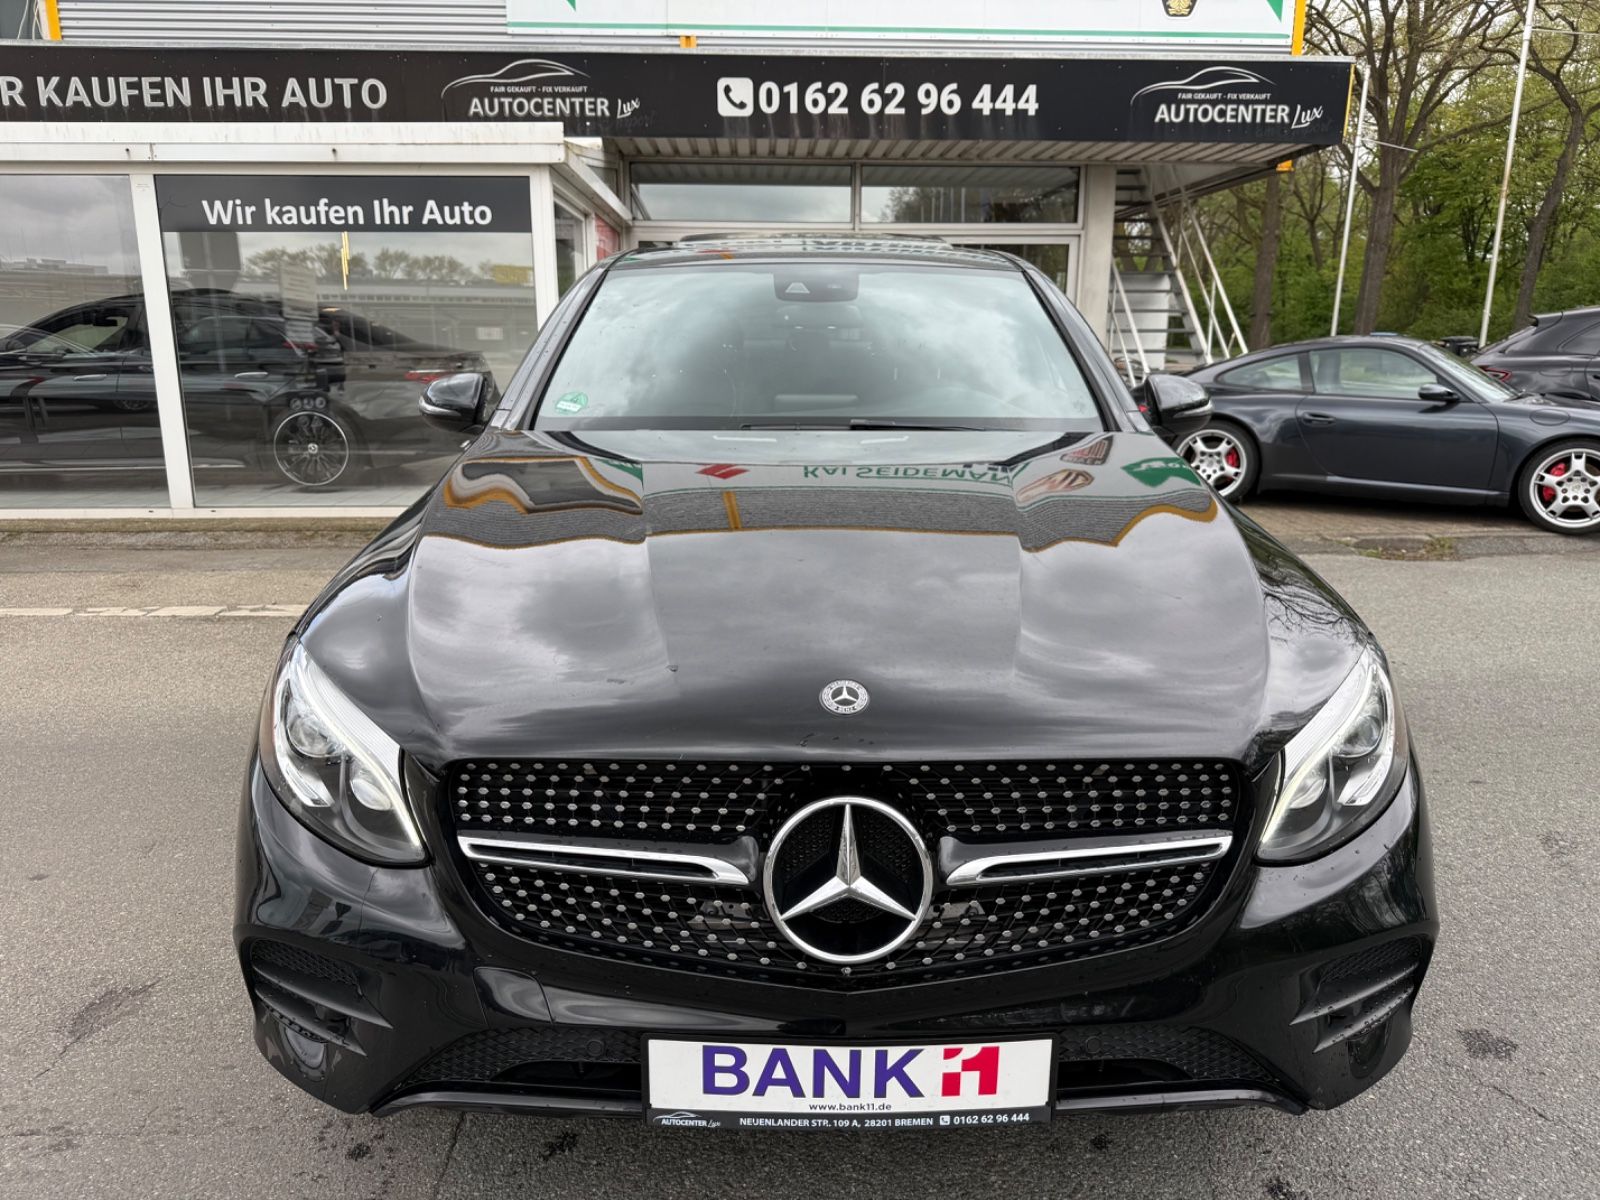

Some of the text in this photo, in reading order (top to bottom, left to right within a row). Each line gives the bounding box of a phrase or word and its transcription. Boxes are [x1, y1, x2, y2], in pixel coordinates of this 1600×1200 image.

[36, 76, 192, 107] KAUFEN
[203, 76, 269, 107] IHR
[281, 77, 387, 109] AUTO
[758, 81, 1039, 116] 0162 62 96 444
[468, 97, 641, 119] AUTOCENTER Lux
[1154, 103, 1323, 129] AUTOCENTER Lux
[202, 198, 492, 225] Wir kaufen Ihr Auto
[808, 1102, 892, 1111] www.bank11.de
[661, 1118, 707, 1127] AUTOCENTER
[739, 1117, 809, 1127] NEUENLANDER
[833, 1119, 849, 1127] 109
[864, 1119, 892, 1127] 28201
[894, 1118, 933, 1127] BREMEN
[953, 1113, 1030, 1124] 0162 62 96 444
